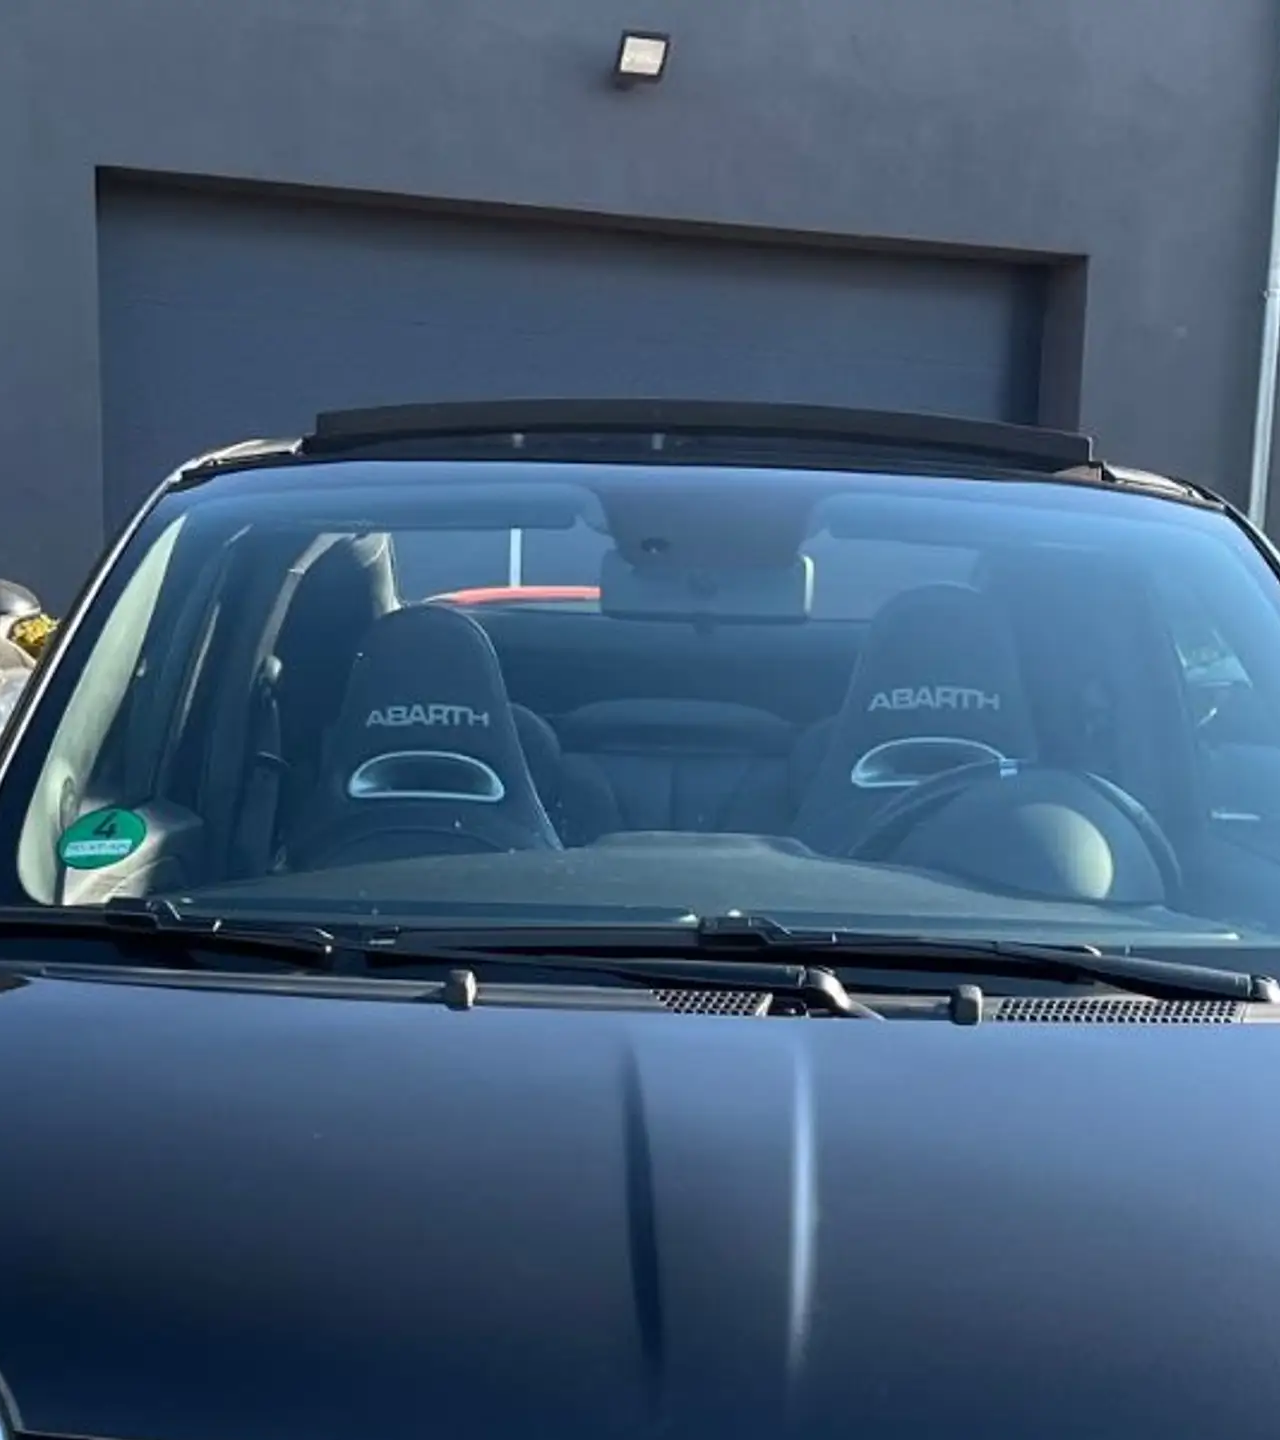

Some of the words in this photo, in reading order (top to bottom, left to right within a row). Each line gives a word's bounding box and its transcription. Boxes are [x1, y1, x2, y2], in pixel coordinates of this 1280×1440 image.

[868, 685, 1001, 712] ABARTH
[366, 703, 490, 728] ABARTH
[92, 811, 118, 839] 4
